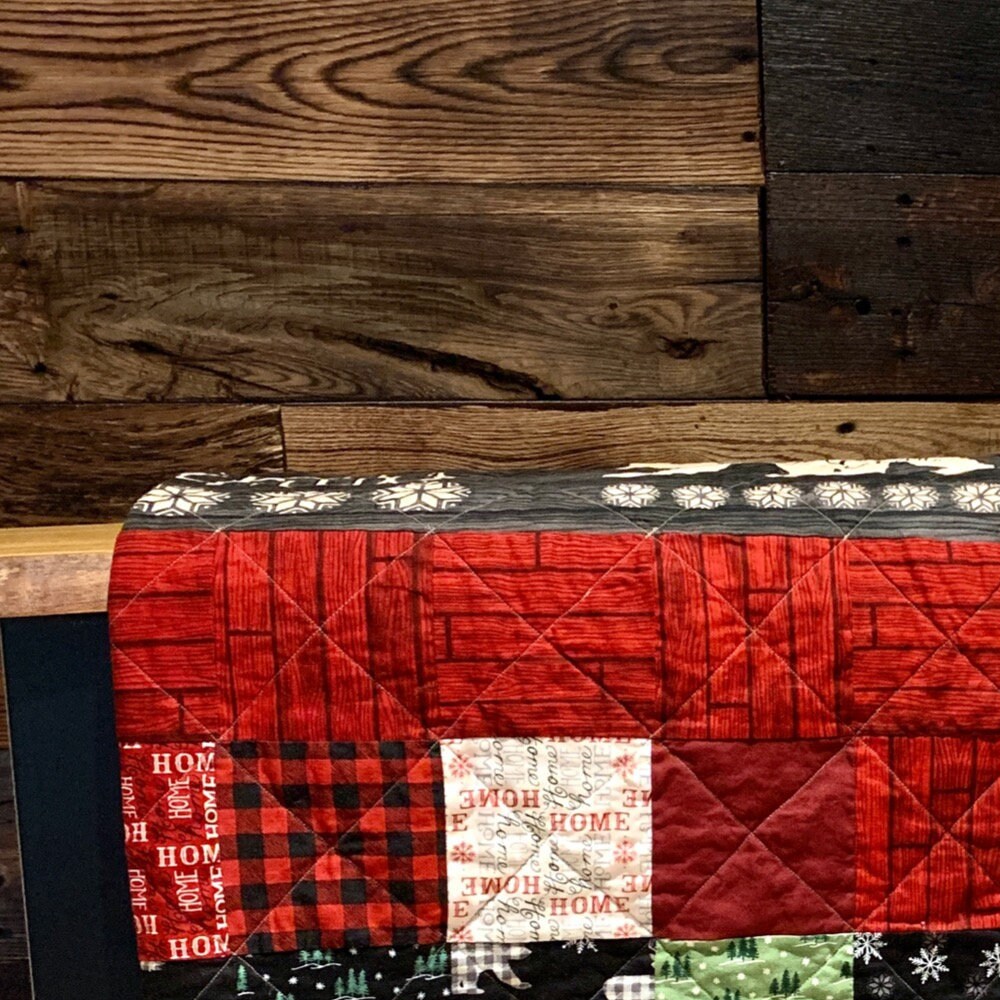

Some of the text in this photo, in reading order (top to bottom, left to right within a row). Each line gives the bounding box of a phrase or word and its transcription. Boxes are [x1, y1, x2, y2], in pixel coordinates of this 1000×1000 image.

[168, 776, 192, 819] HOME
[459, 789, 540, 809] HOME
[550, 812, 630, 832] HOME
[174, 869, 202, 912] HOME
[462, 876, 540, 896] HOME
[550, 896, 630, 915] HOME
